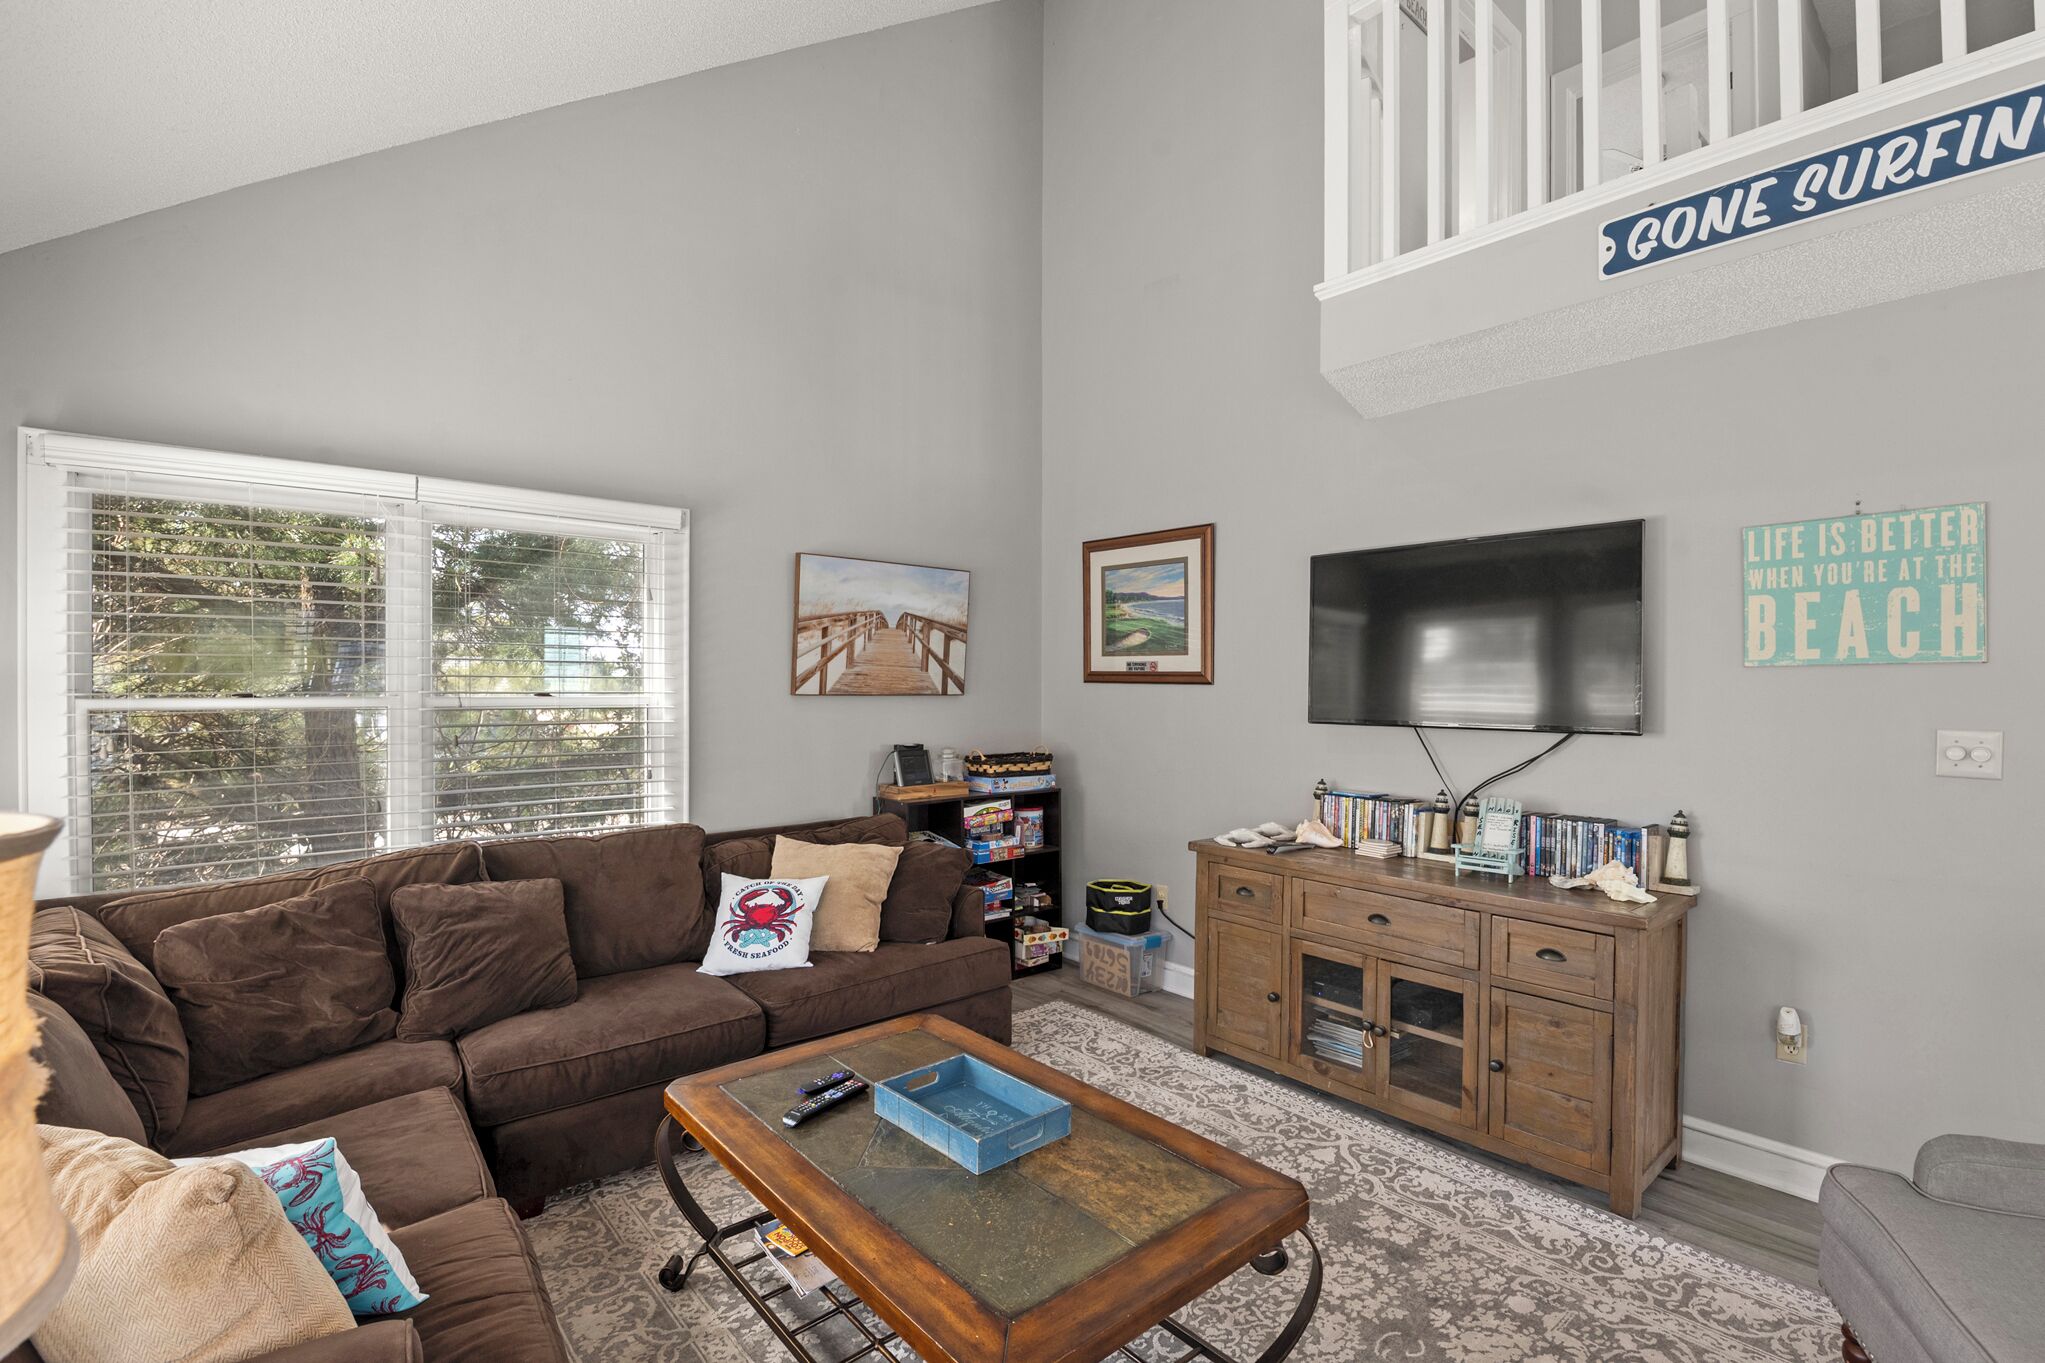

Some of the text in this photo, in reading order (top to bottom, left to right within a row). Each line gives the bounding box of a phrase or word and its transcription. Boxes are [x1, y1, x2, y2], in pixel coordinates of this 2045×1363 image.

[1627, 95, 2045, 261] GONE SURFIN
[1748, 508, 1978, 562] LIFE IS BETTER
[1749, 553, 1977, 590] WHEN YOU'RE AT THE
[1748, 582, 1978, 661] BEACH
[735, 881, 762, 897] CATCH
[791, 884, 804, 897] DAY
[724, 940, 790, 959] FRESH SEAFOOD
